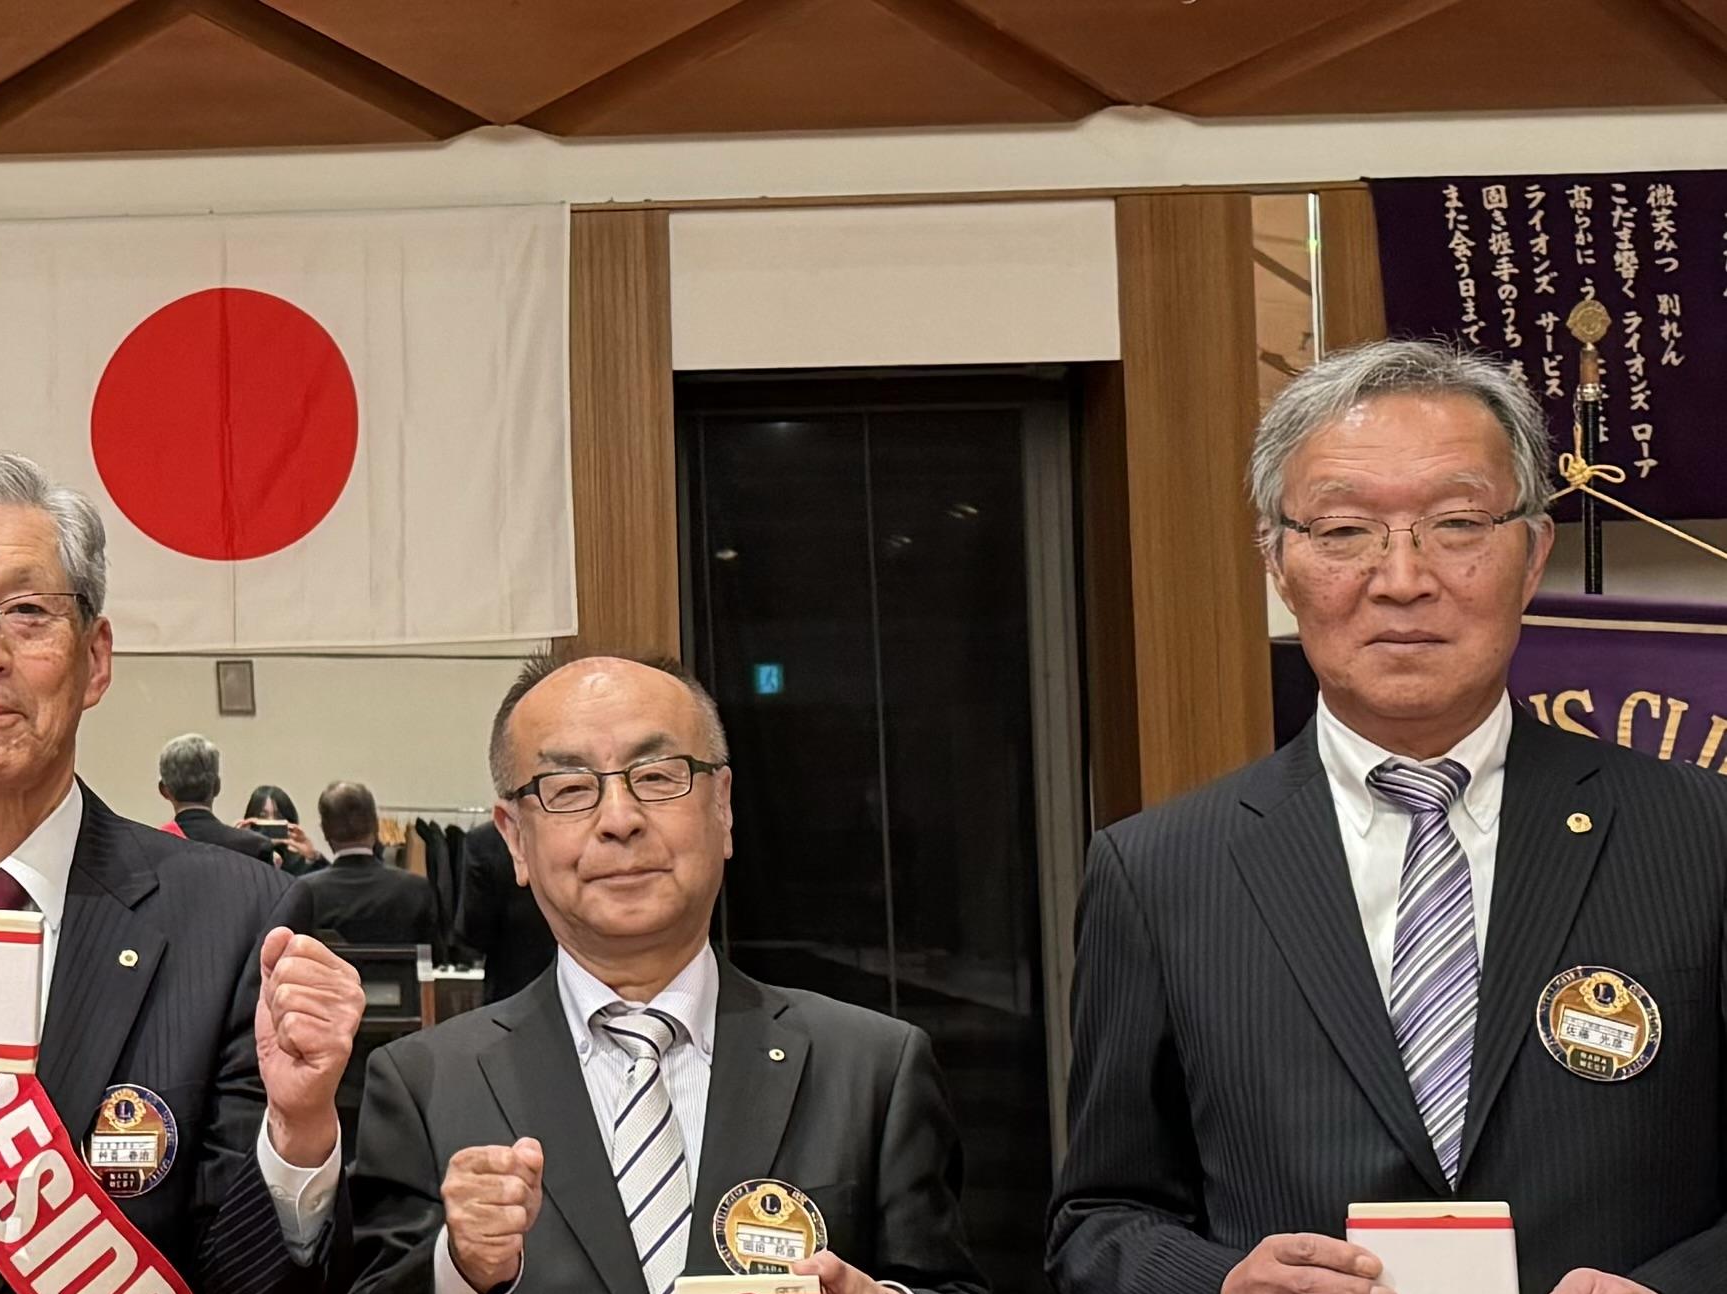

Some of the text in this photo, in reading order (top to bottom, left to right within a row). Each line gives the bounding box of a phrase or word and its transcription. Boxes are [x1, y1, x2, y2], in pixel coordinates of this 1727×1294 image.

[1442, 184, 1487, 345] また会う日まで
[1481, 184, 1523, 348] 固き握手のうち
[1524, 184, 1564, 397] ライオンズ サービス
[1565, 185, 1596, 265] 高らかに
[1646, 184, 1685, 366] 微笑みつ 別れん
[1610, 183, 1658, 479] こだま響く ライオンズ ローア
